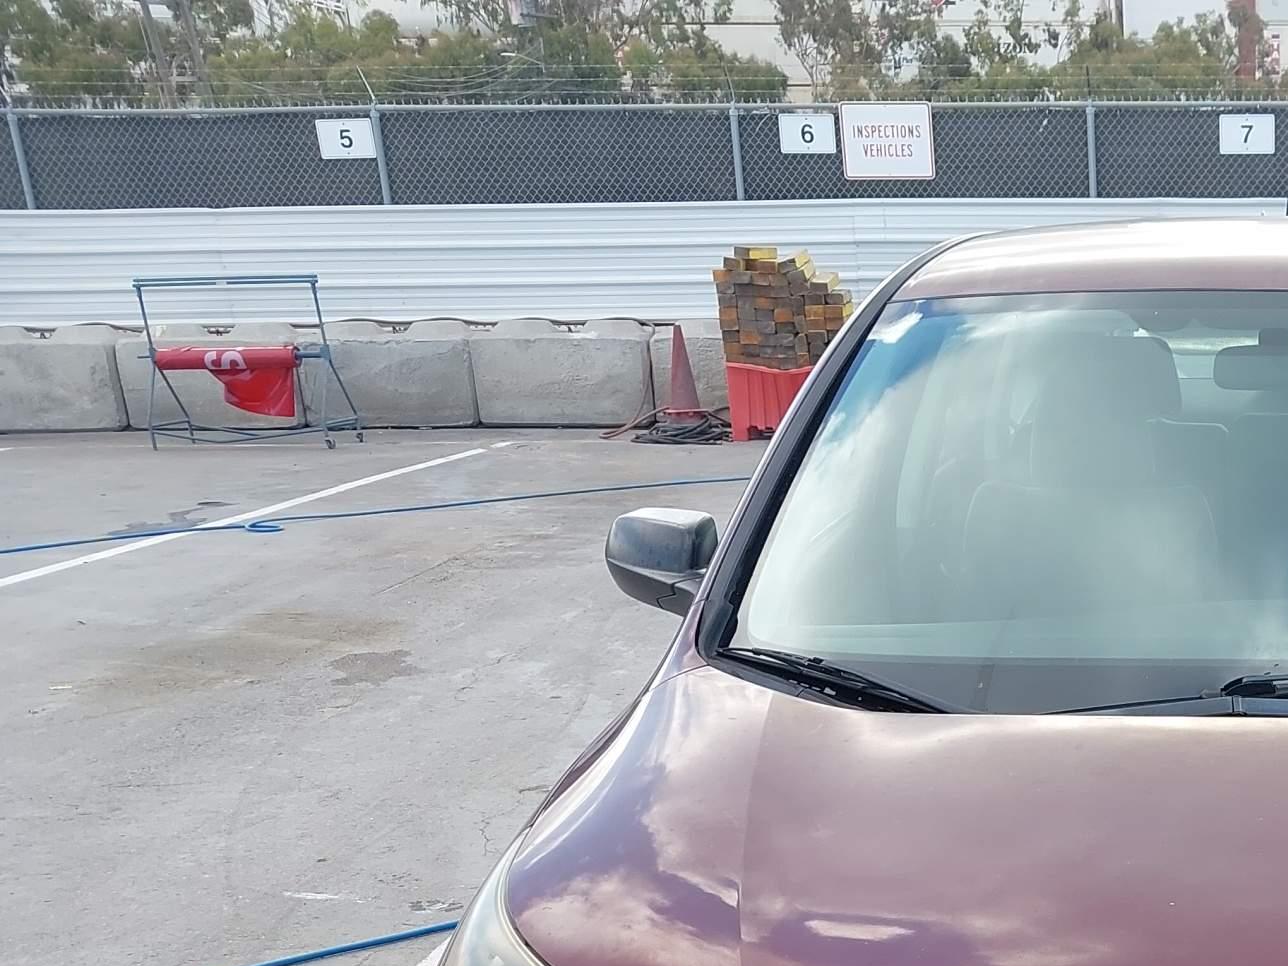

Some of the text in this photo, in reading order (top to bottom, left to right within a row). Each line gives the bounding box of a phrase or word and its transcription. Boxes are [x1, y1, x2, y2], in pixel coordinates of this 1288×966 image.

[340, 129, 353, 148] 5
[801, 124, 815, 143] 6
[852, 125, 921, 138] INSPECTIONS
[1240, 125, 1253, 143] 7
[862, 143, 913, 158] VEHICLES
